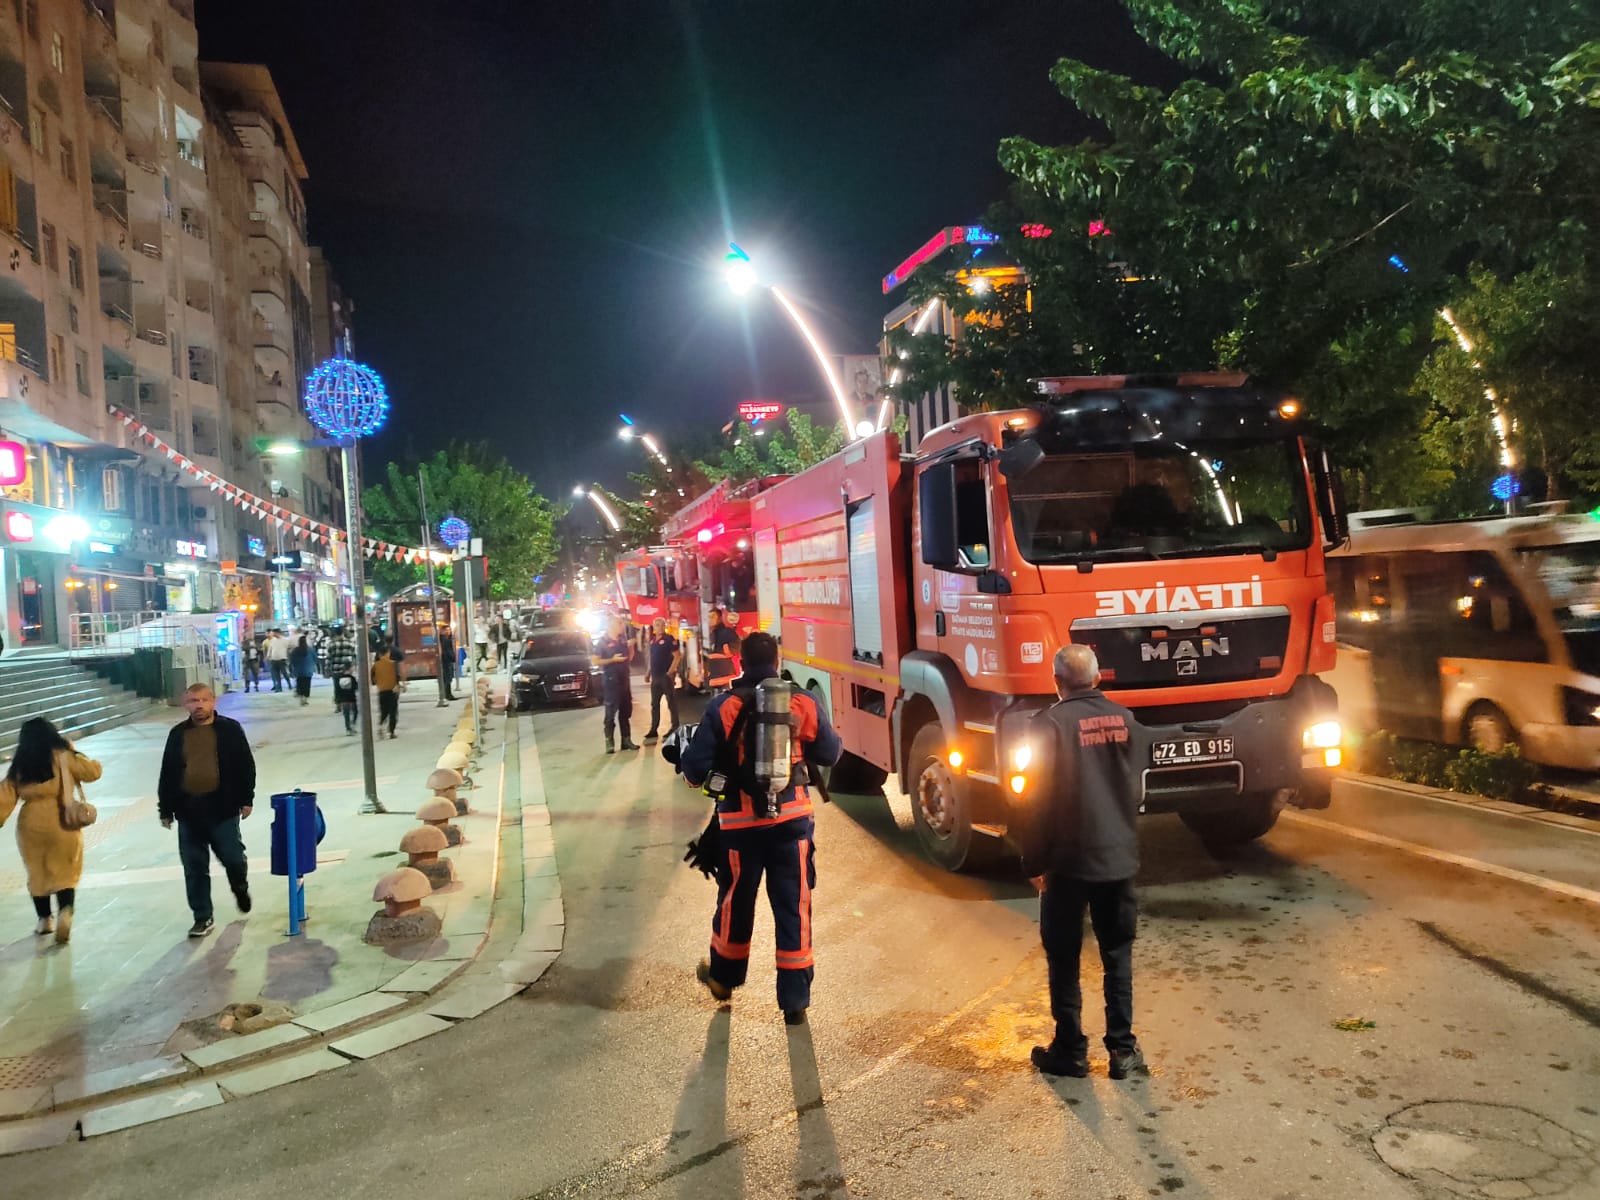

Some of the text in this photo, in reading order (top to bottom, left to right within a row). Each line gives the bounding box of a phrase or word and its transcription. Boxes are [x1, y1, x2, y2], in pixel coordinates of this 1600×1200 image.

[1140, 636, 1230, 662] MAN
[1078, 715, 1126, 731] BATMAN
[1160, 739, 1232, 758] 72 ED 915
